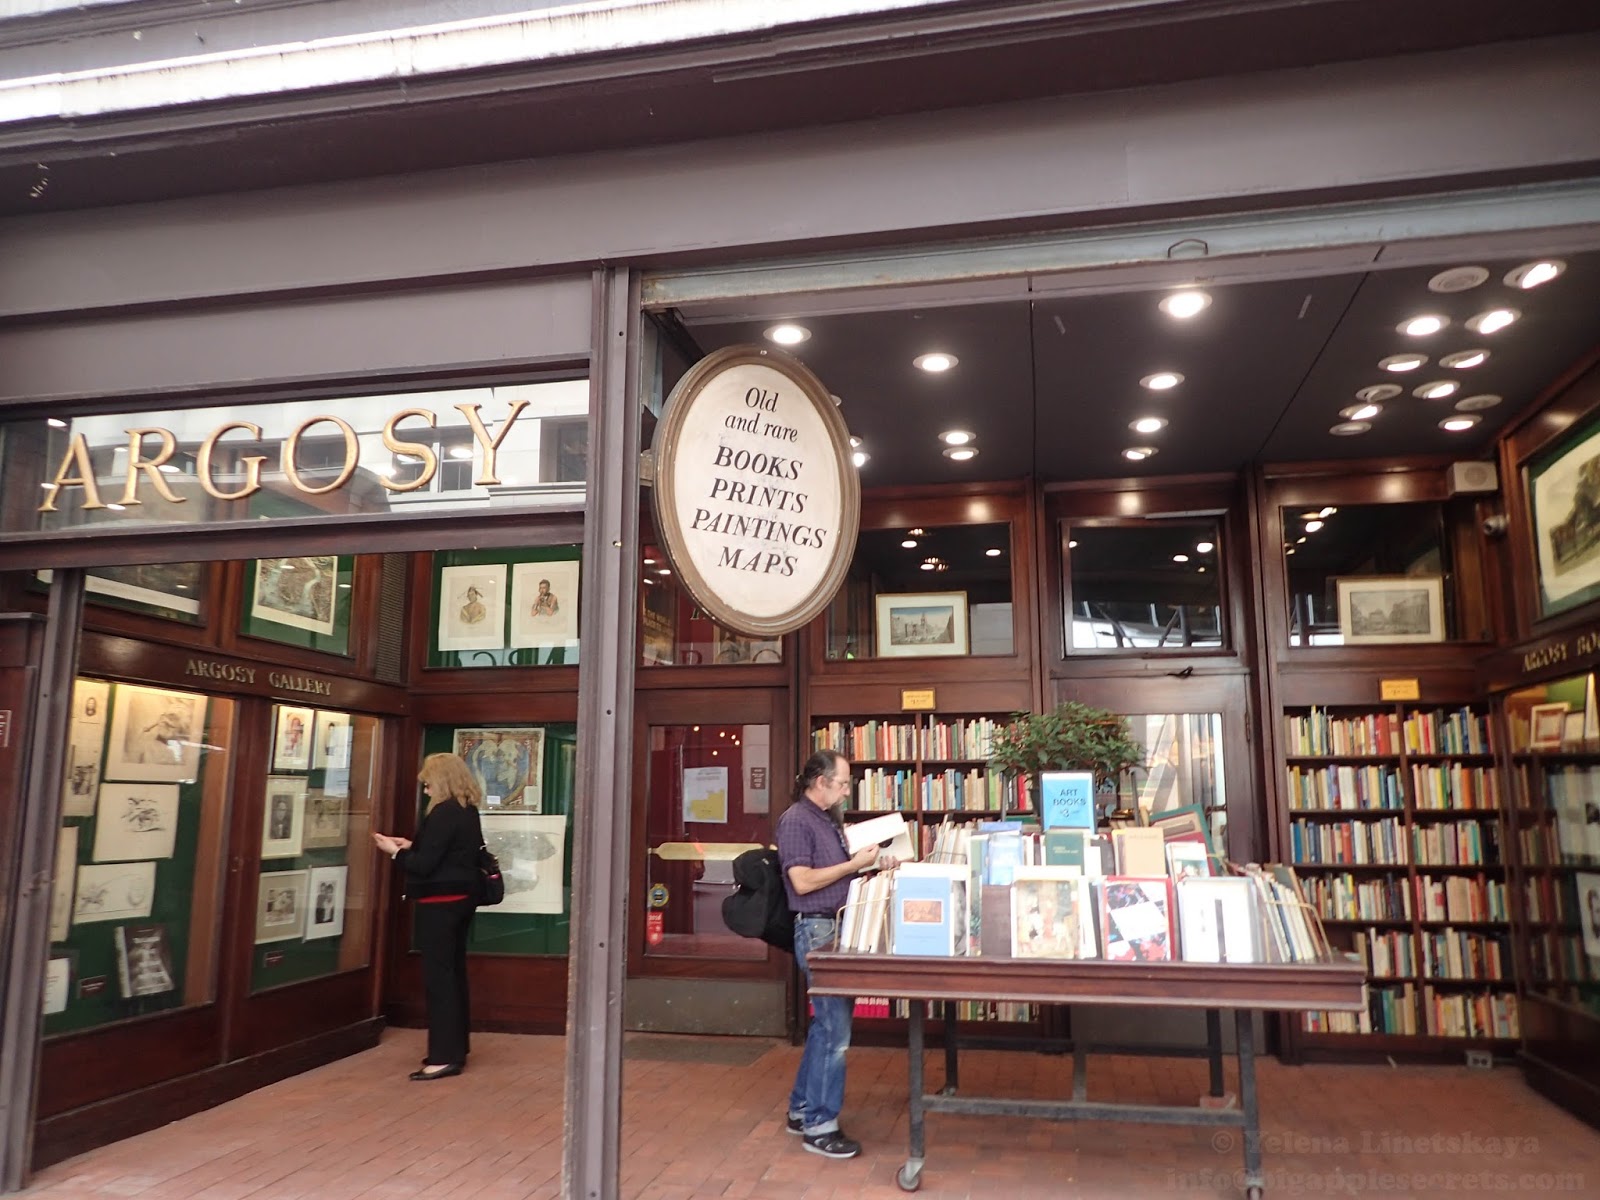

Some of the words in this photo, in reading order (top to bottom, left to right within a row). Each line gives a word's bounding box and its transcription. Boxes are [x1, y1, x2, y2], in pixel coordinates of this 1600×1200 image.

[745, 387, 779, 412] Old
[724, 413, 761, 434] and
[763, 422, 798, 443] rare
[38, 399, 531, 511] ARGOSY
[713, 445, 803, 480] BOOKS
[709, 477, 808, 514] PRINTS
[690, 508, 827, 549] PAINTINGS
[717, 546, 798, 577] MAPS
[185, 659, 256, 684] ARGOSY
[269, 671, 332, 696] GALLERY
[1053, 798, 1087, 806] BOOKS
